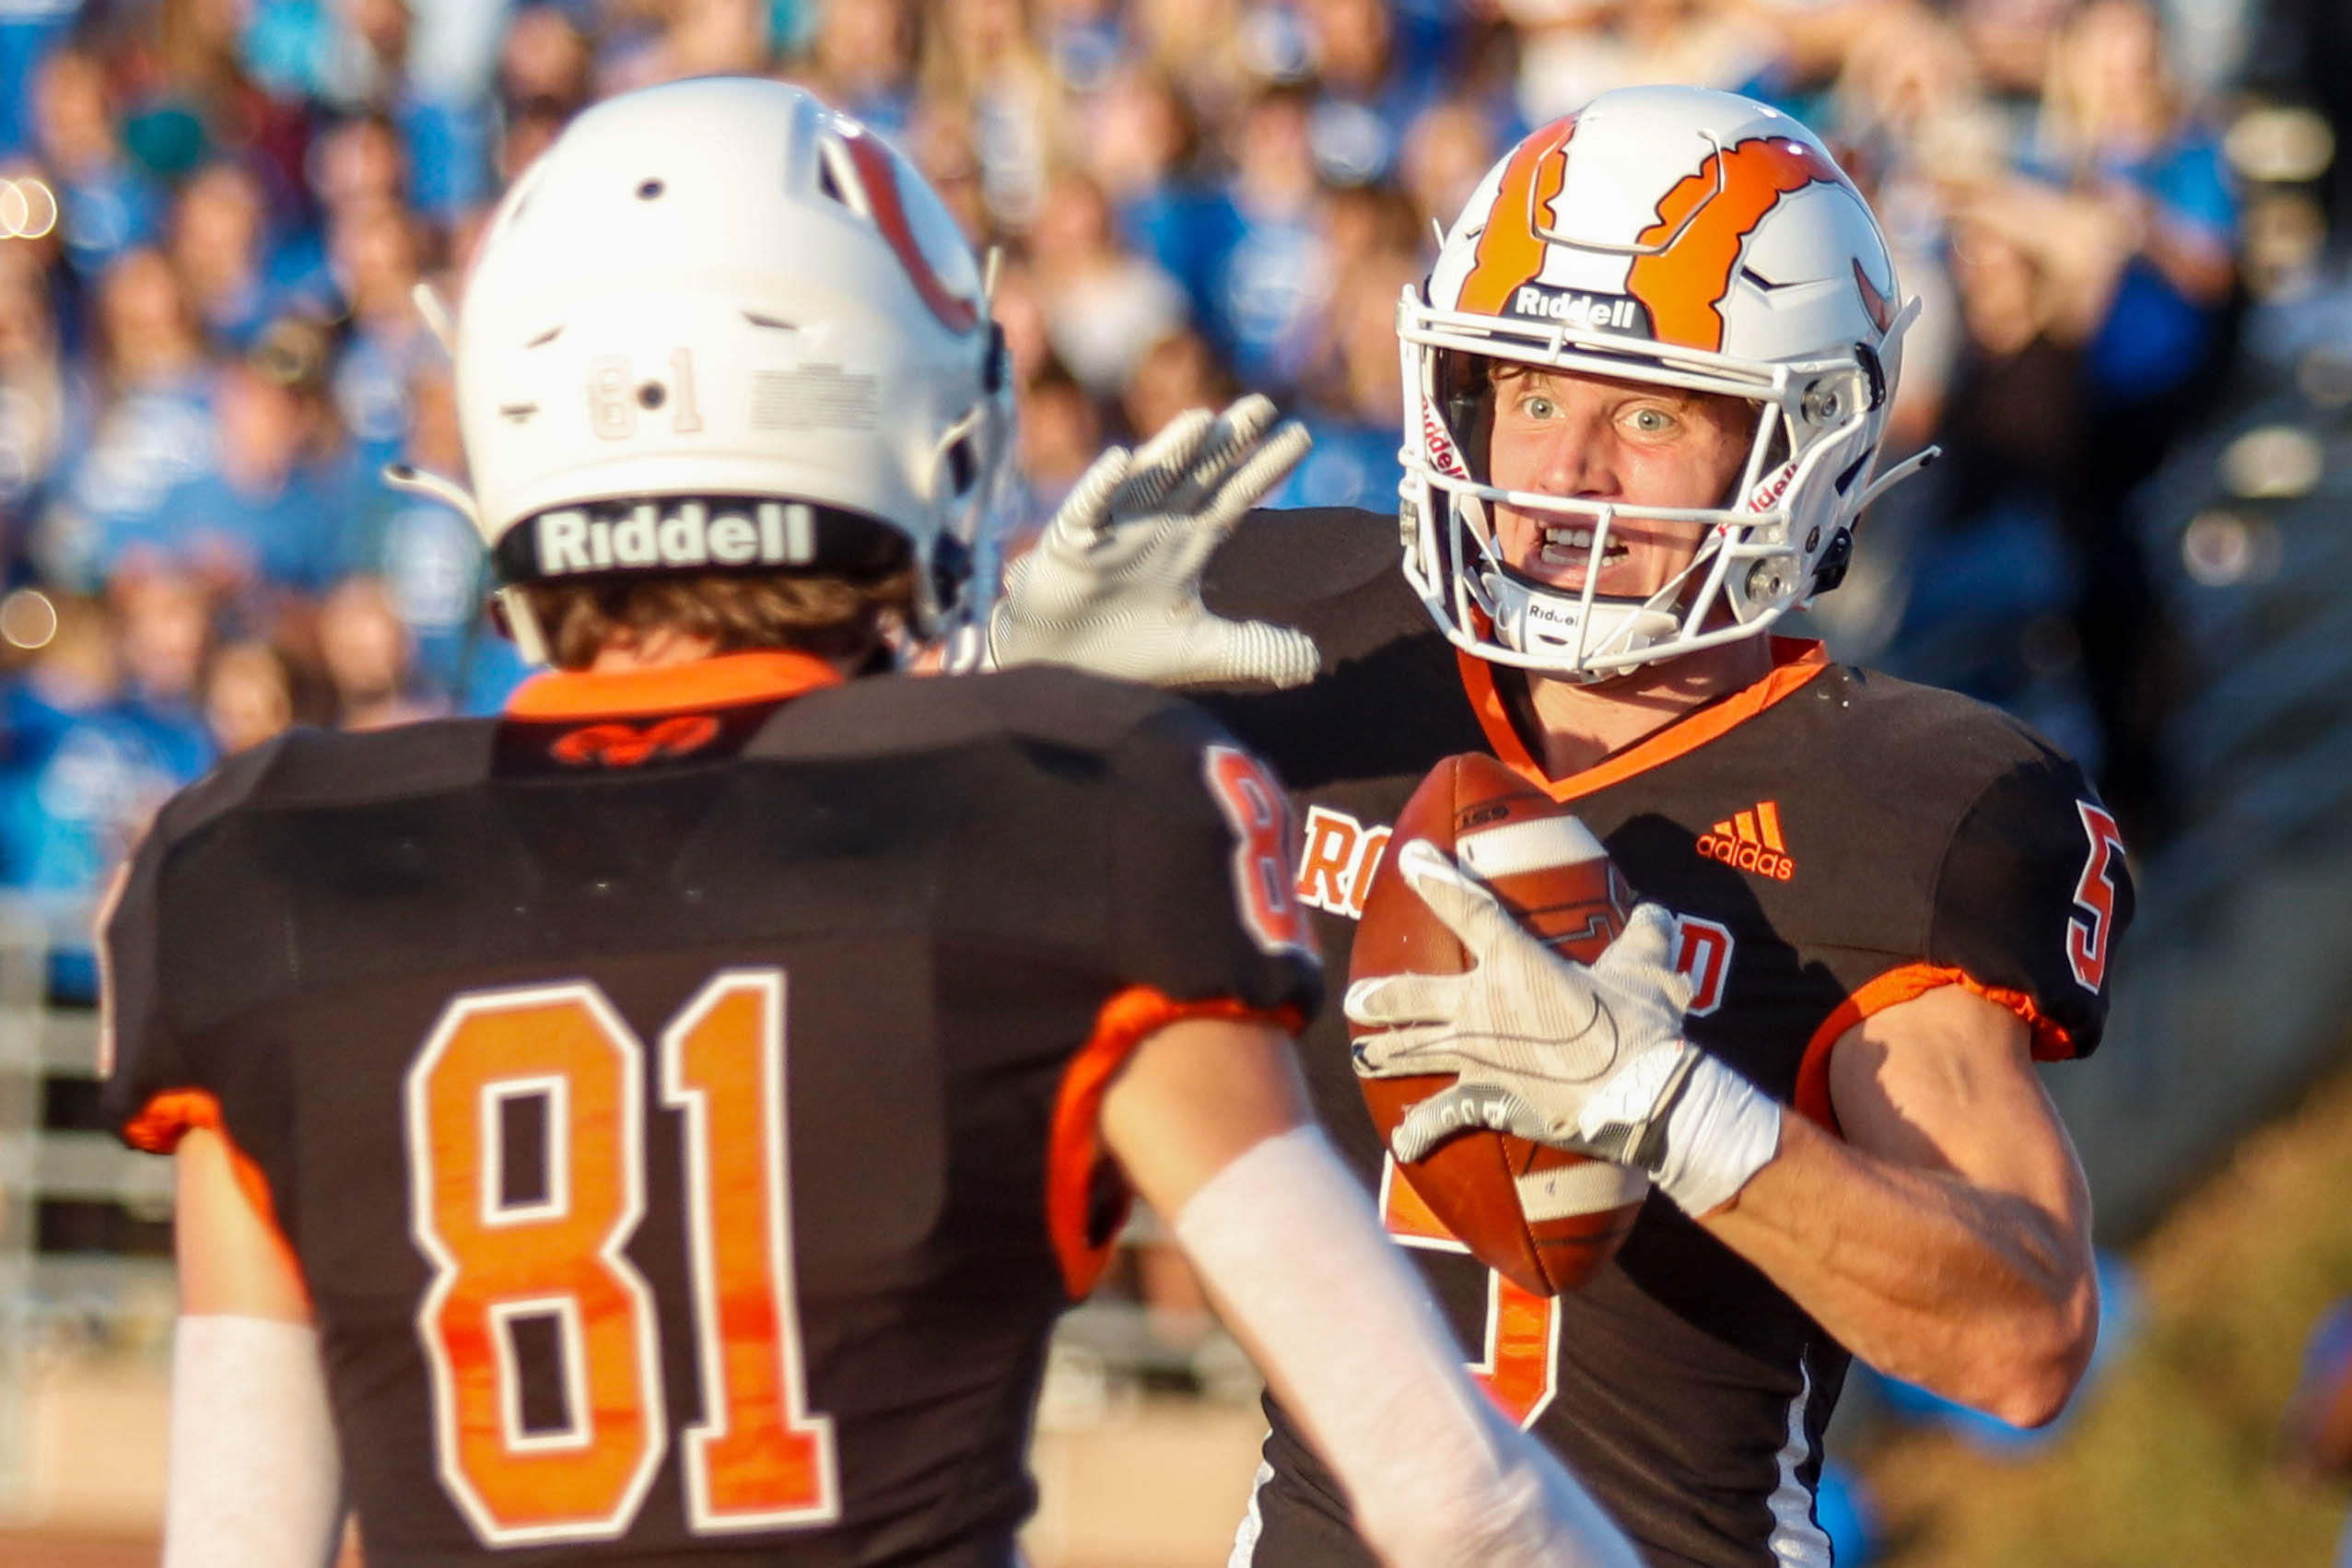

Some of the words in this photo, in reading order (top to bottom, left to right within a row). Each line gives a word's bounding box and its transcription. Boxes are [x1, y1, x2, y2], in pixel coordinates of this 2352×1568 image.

[1515, 286, 1636, 329] Riddell
[587, 346, 704, 440] 81
[537, 503, 812, 575] Riddell
[1203, 744, 1323, 965] 8
[1696, 835, 1794, 881] adidas
[2066, 799, 2125, 995] 5
[407, 970, 838, 1547] 81
